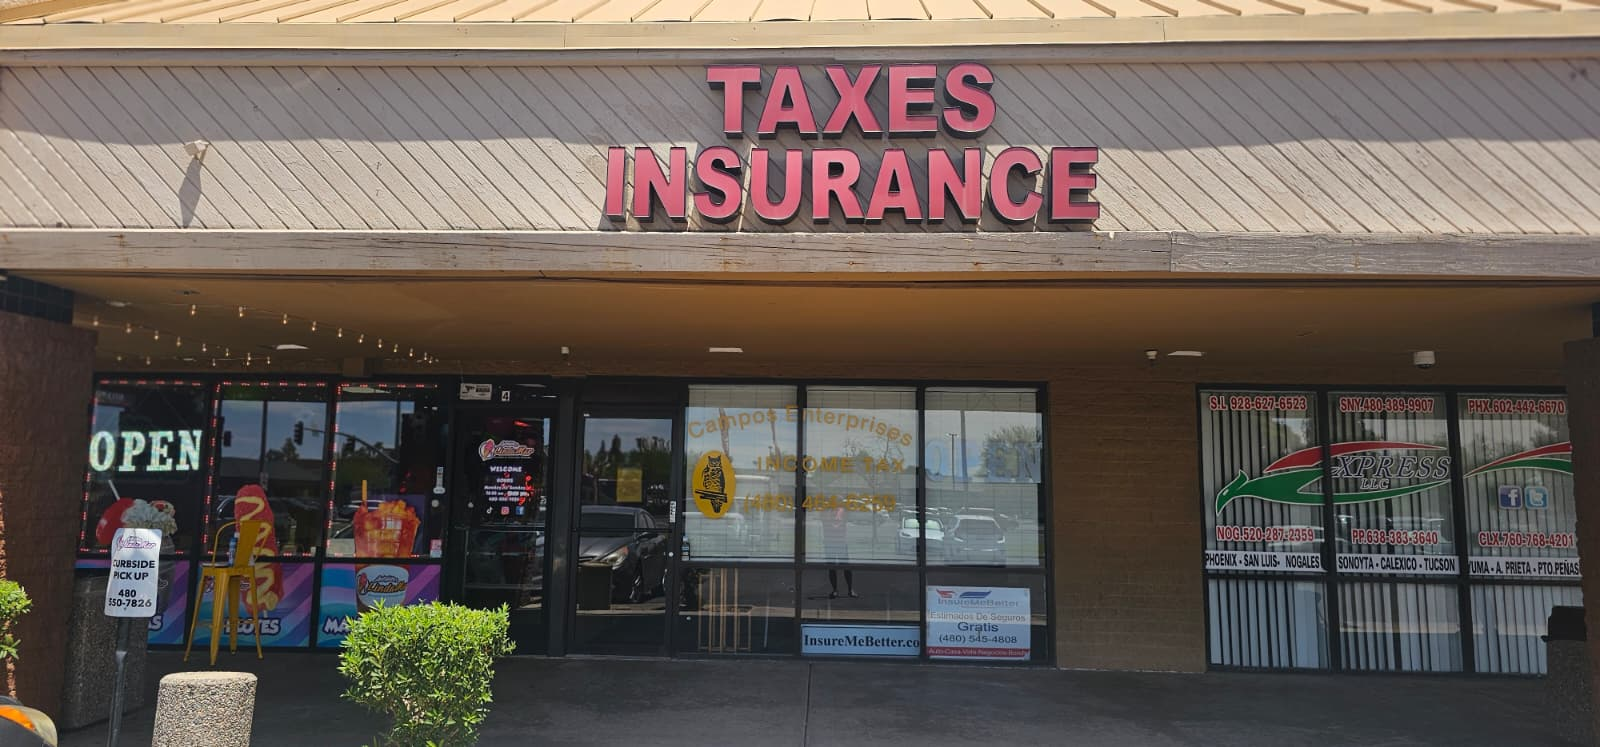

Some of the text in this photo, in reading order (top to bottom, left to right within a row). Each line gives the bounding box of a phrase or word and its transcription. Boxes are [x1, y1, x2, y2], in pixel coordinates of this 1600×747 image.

[706, 62, 997, 137] TAXES
[605, 146, 1101, 224] INSURANCE
[502, 391, 509, 400] 4
[1231, 396, 1307, 410] 928-627-6523
[688, 405, 913, 446] Campos Enterprises
[89, 430, 202, 471] OPEN
[757, 455, 904, 473] INCOME TAX
[1360, 478, 1390, 489] LLC
[1216, 526, 1314, 541] NOG.520-287-2359
[1352, 530, 1438, 544] PP.638-383-3640
[1478, 532, 1574, 547] CLX.760-768-4201
[113, 560, 155, 569] CURBSIDE
[1205, 553, 1236, 567] PHOENIX
[1243, 555, 1260, 567] SAN
[1285, 556, 1320, 569] NOGALES
[1338, 556, 1455, 571] SONOYTA CALEXICO TUCSON
[1505, 562, 1531, 574] PRIETA
[113, 571, 149, 580] PICK UP
[118, 589, 137, 598] 480
[109, 598, 152, 608] 550-7826
[930, 611, 1025, 623] Estimados De Seguros
[957, 622, 999, 632] Gratis
[804, 634, 920, 648] InsureMeBetter.co
[939, 634, 1017, 644] (480) 545-4808
